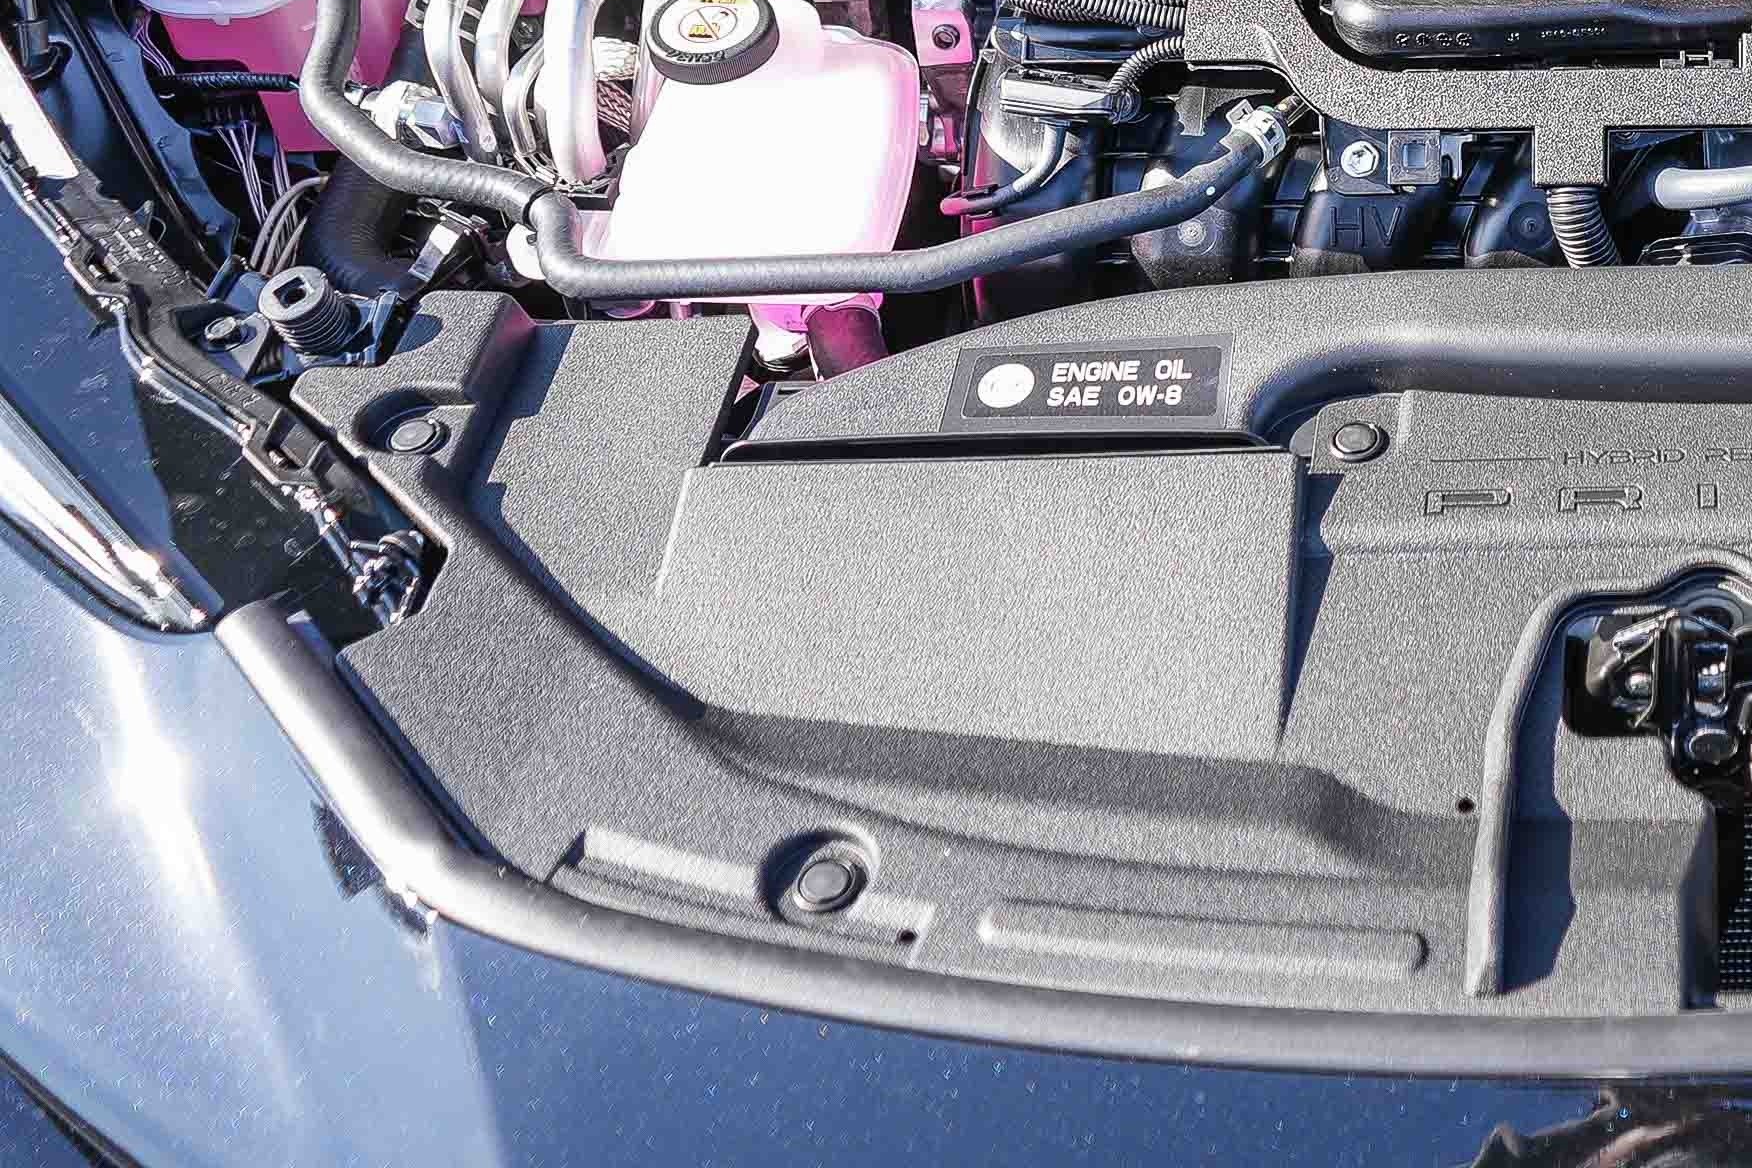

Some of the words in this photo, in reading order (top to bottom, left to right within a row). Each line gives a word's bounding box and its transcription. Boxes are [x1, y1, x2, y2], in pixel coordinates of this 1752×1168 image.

[1329, 205, 1406, 248] HV
[1050, 360, 1141, 383] ENGINE
[1154, 358, 1193, 381] OIL
[1046, 385, 1101, 407] SAE
[1117, 384, 1183, 406] 0W-8
[1562, 446, 1686, 466] HYBRID
